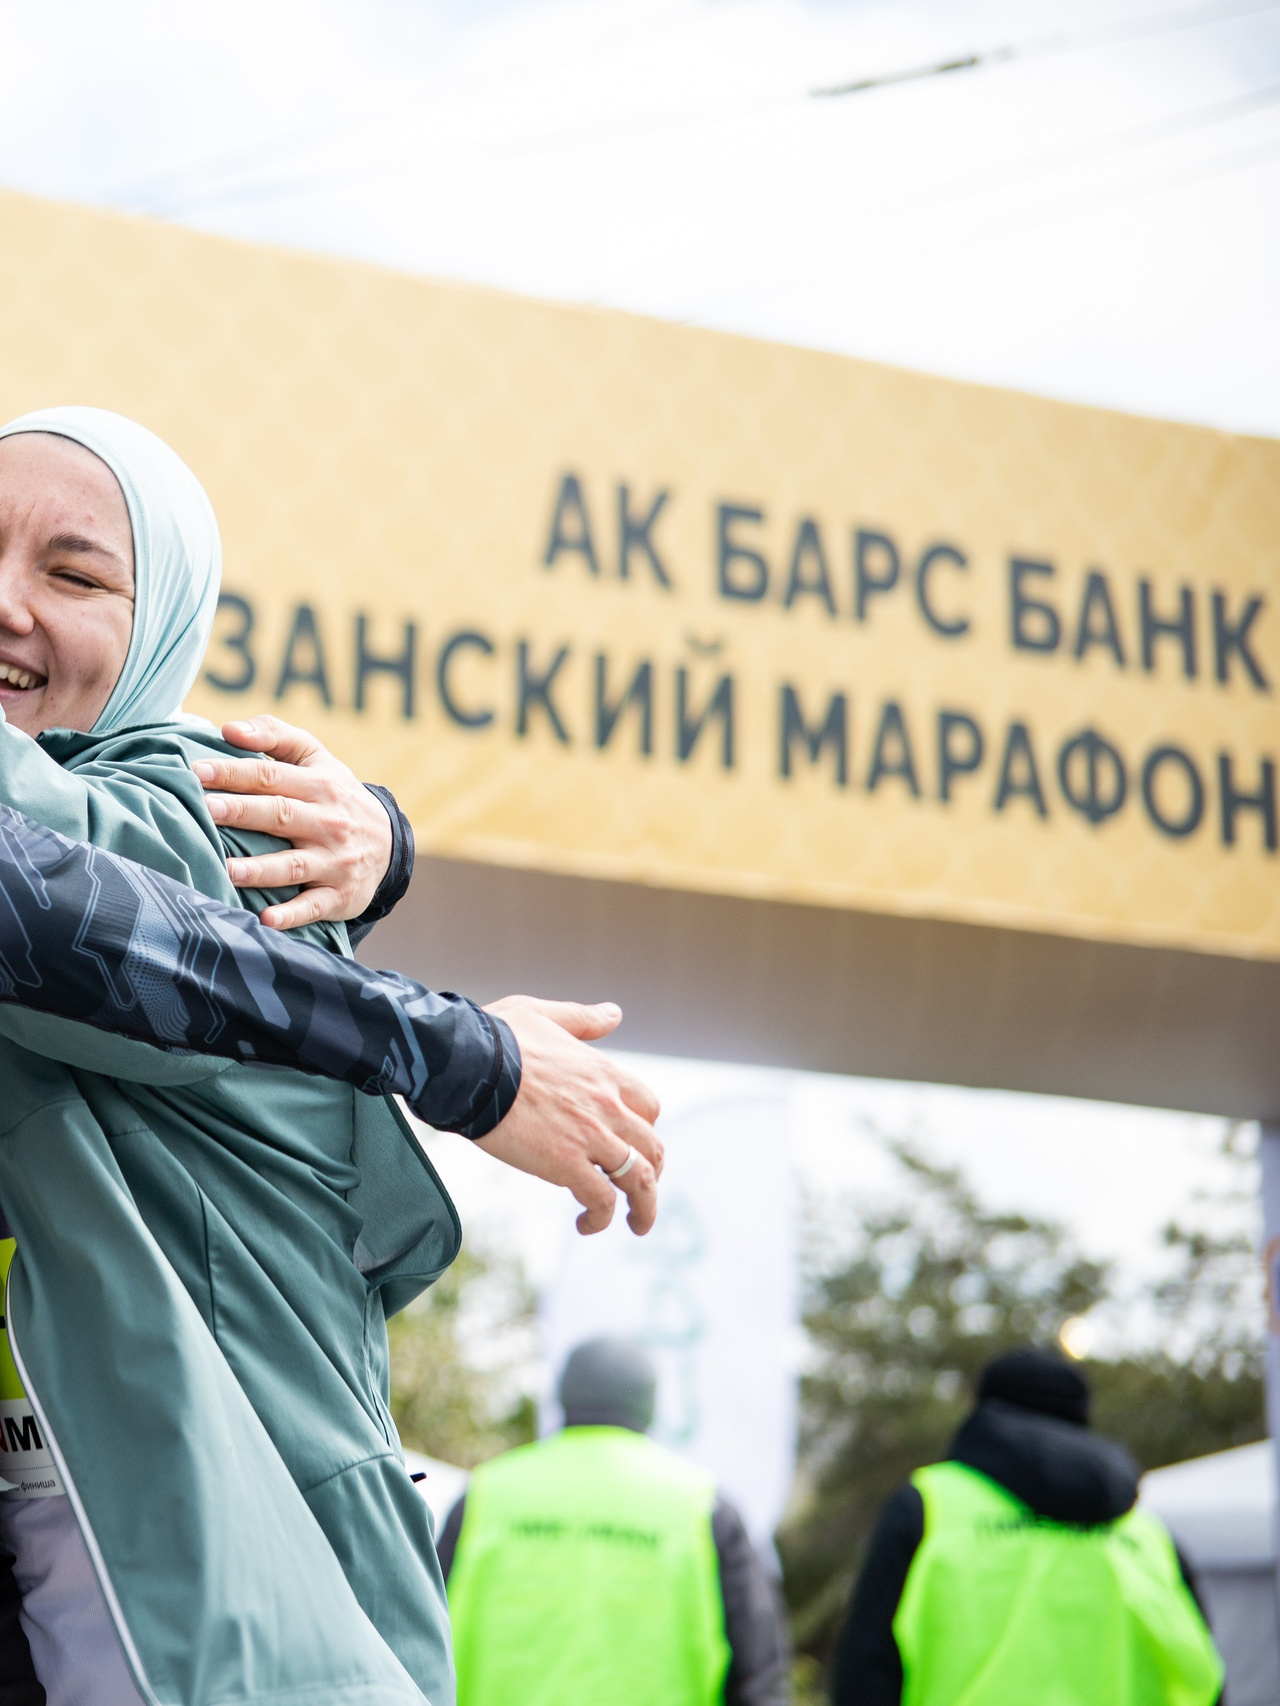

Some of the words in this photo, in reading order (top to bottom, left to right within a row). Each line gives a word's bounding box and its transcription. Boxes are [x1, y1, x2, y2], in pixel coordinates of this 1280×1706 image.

[542, 471, 674, 593] АК
[715, 499, 972, 640] БАРС
[1007, 556, 1274, 693] БАНК
[778, 679, 1280, 854] МАРАФОН
[20, 1478, 56, 1493] финиша
